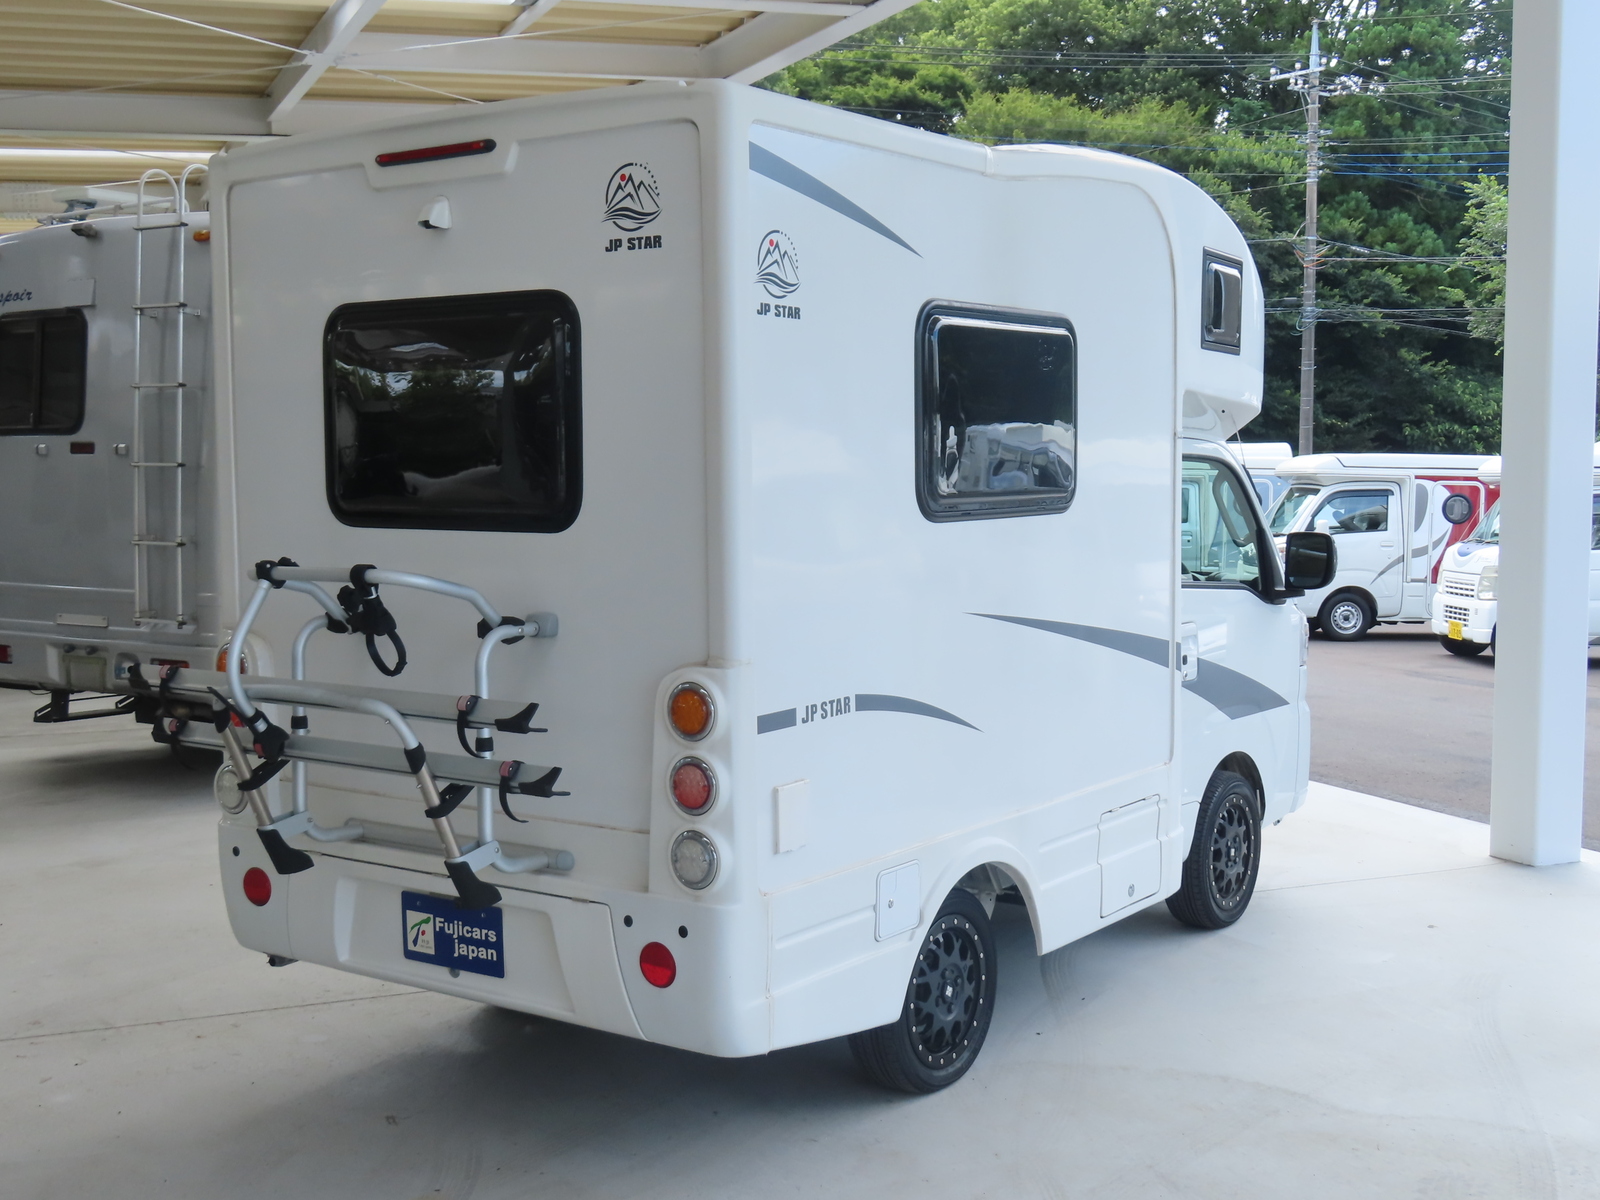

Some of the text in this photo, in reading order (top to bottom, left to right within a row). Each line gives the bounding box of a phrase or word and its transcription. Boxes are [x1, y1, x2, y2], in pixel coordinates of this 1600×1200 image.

[604, 235, 662, 252] JP STAR
[756, 302, 801, 320] JP STAR
[801, 696, 851, 724] JP STAR
[435, 917, 497, 942] Fujicars
[453, 939, 497, 961] japan
